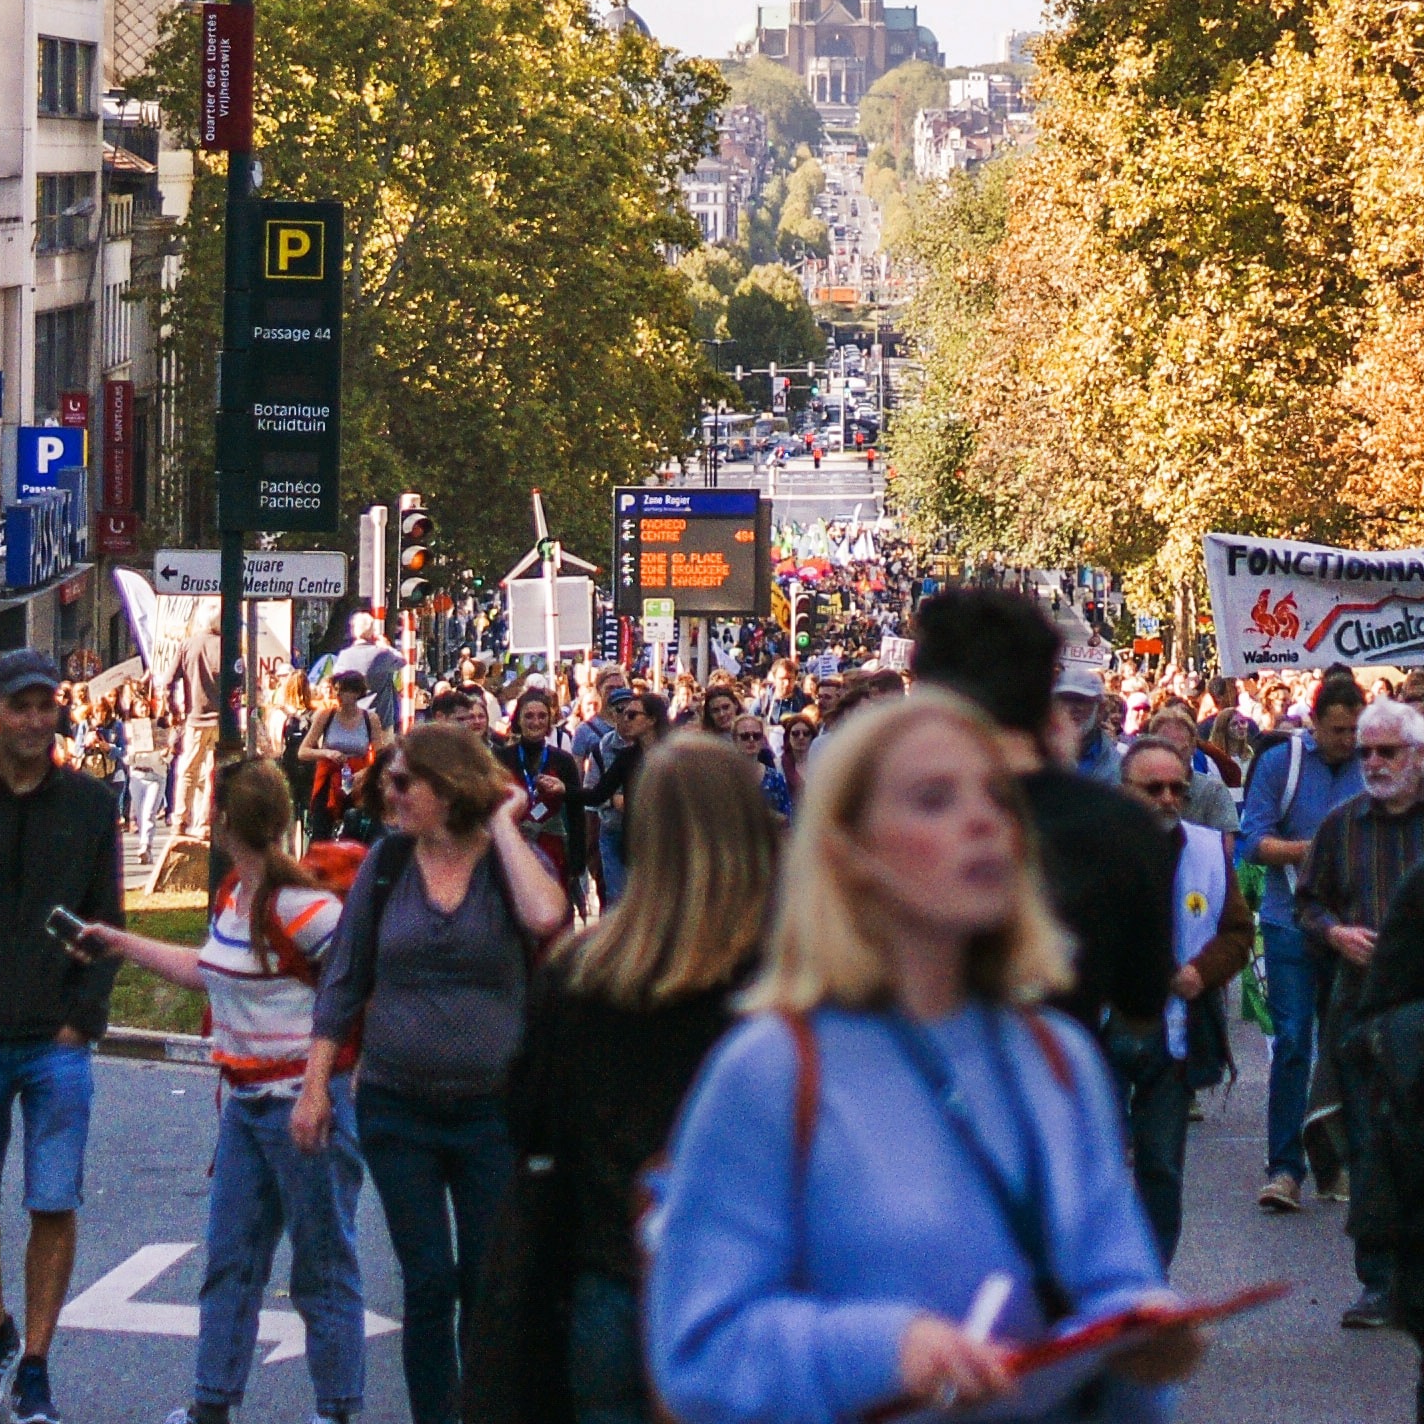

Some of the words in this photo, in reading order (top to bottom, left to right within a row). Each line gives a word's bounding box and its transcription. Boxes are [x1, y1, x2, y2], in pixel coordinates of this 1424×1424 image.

[206, 67, 216, 89] des
[219, 38, 232, 118] Vrijheidswijk
[205, 92, 216, 142] Quartier
[278, 228, 312, 271] P
[253, 326, 311, 342] Passage
[313, 327, 332, 340] 44
[253, 402, 330, 419] Botanique
[257, 418, 327, 432] Kruidtuin
[37, 435, 65, 474] P
[259, 480, 322, 494] Pachéco
[259, 495, 322, 509] Pacheco
[643, 494, 663, 505] Zone
[664, 494, 691, 508] Rogier
[640, 519, 687, 531] PACHECO
[640, 530, 681, 543] CENTRE
[640, 552, 668, 564] ZONE
[690, 552, 723, 564] PLACE
[640, 564, 668, 575] ZONE
[671, 564, 730, 576] BROUCKERE
[243, 576, 294, 595] Meeting
[298, 576, 342, 594] Centre
[640, 575, 668, 586] ZONE
[671, 575, 725, 587] DANSAERT
[1242, 649, 1300, 665] Wallonie
